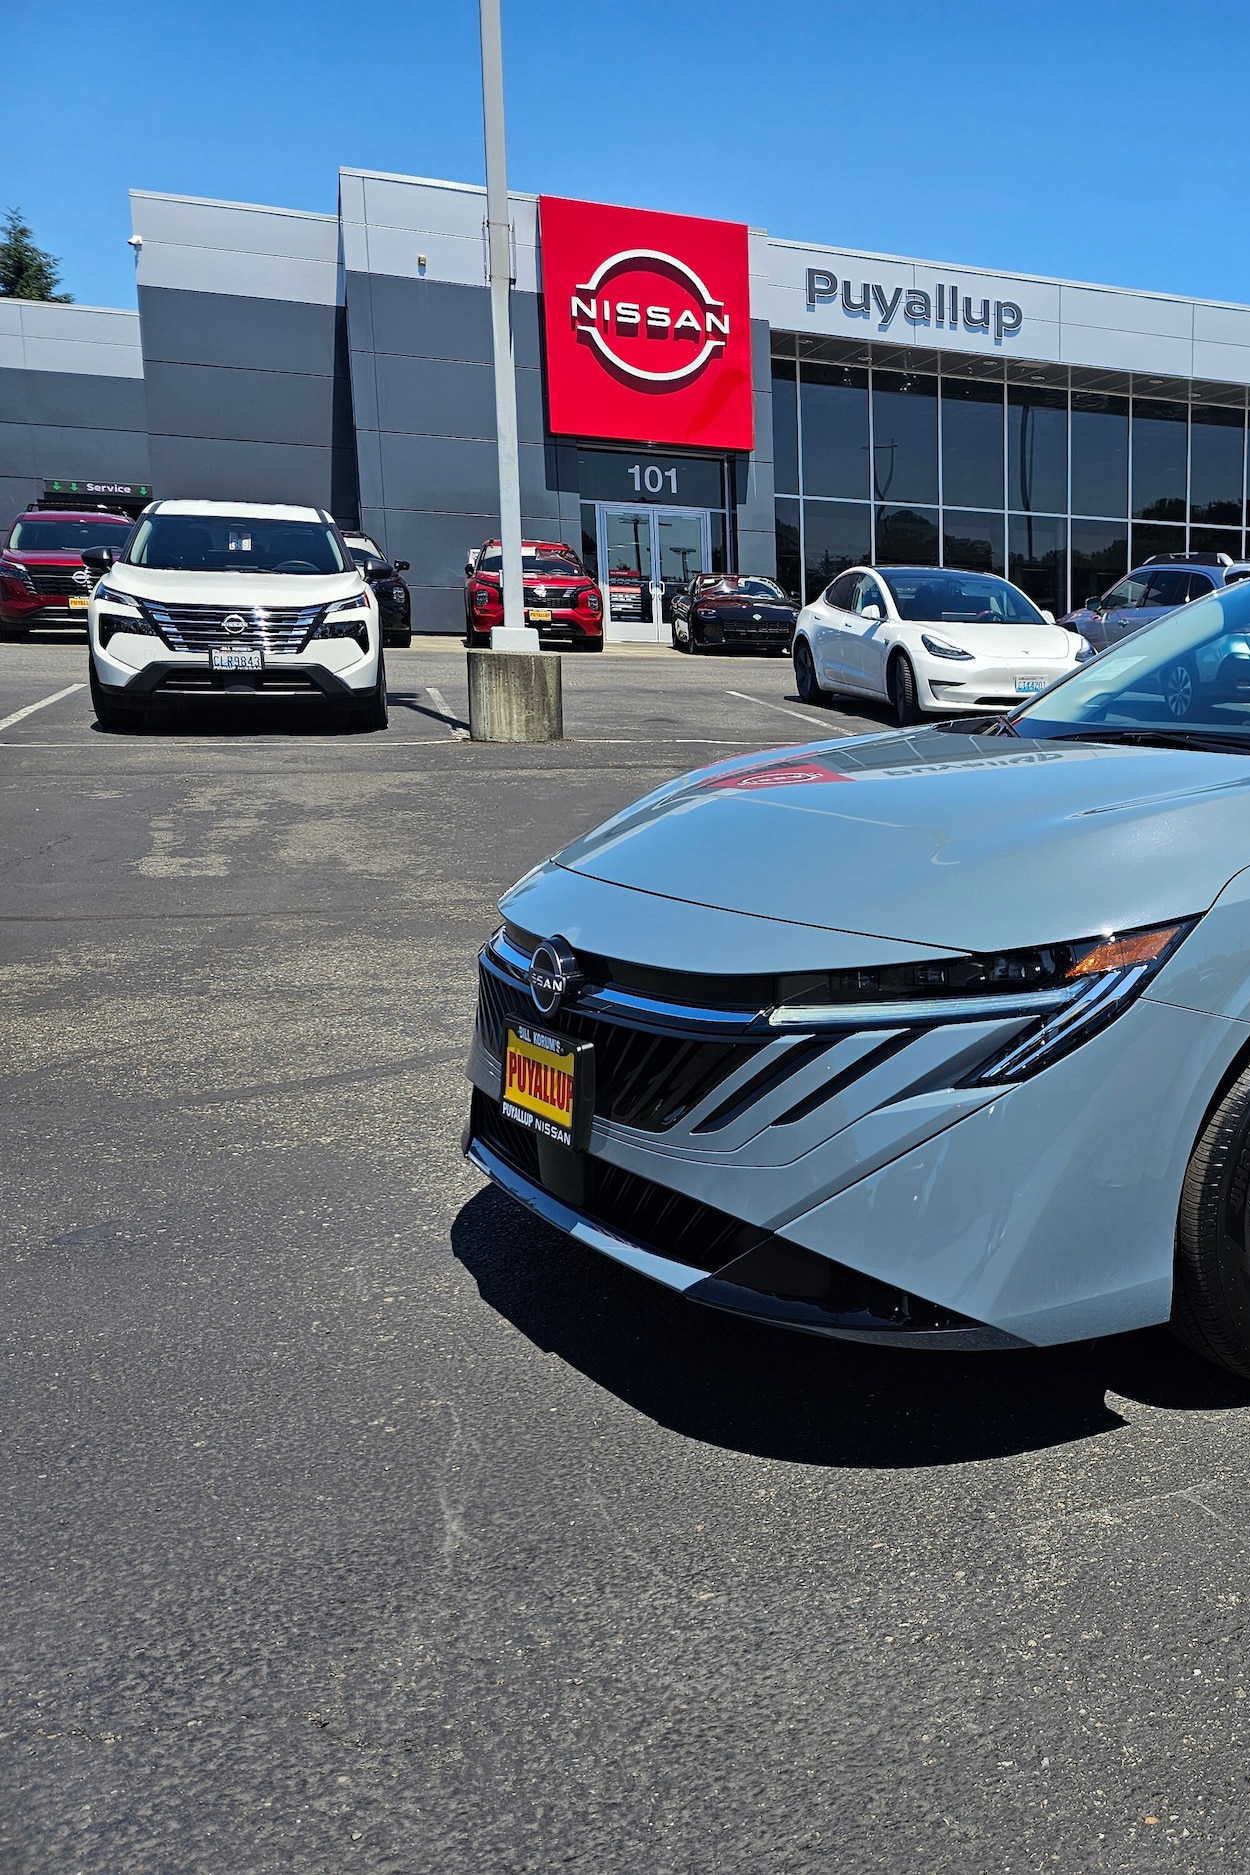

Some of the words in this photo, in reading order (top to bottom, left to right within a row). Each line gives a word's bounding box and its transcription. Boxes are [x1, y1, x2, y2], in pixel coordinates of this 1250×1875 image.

[570, 295, 730, 335] NISSAN
[805, 266, 1023, 341] Puyallup
[86, 483, 132, 494] Service
[627, 464, 678, 494] 101
[213, 656, 260, 668] CLR9843
[519, 1026, 532, 1044] BILL
[533, 1031, 562, 1053] KORUM'S
[508, 1051, 574, 1113] PUYALLUP
[502, 1102, 533, 1129] PUYALLUP
[534, 1118, 571, 1146] NISSAN
